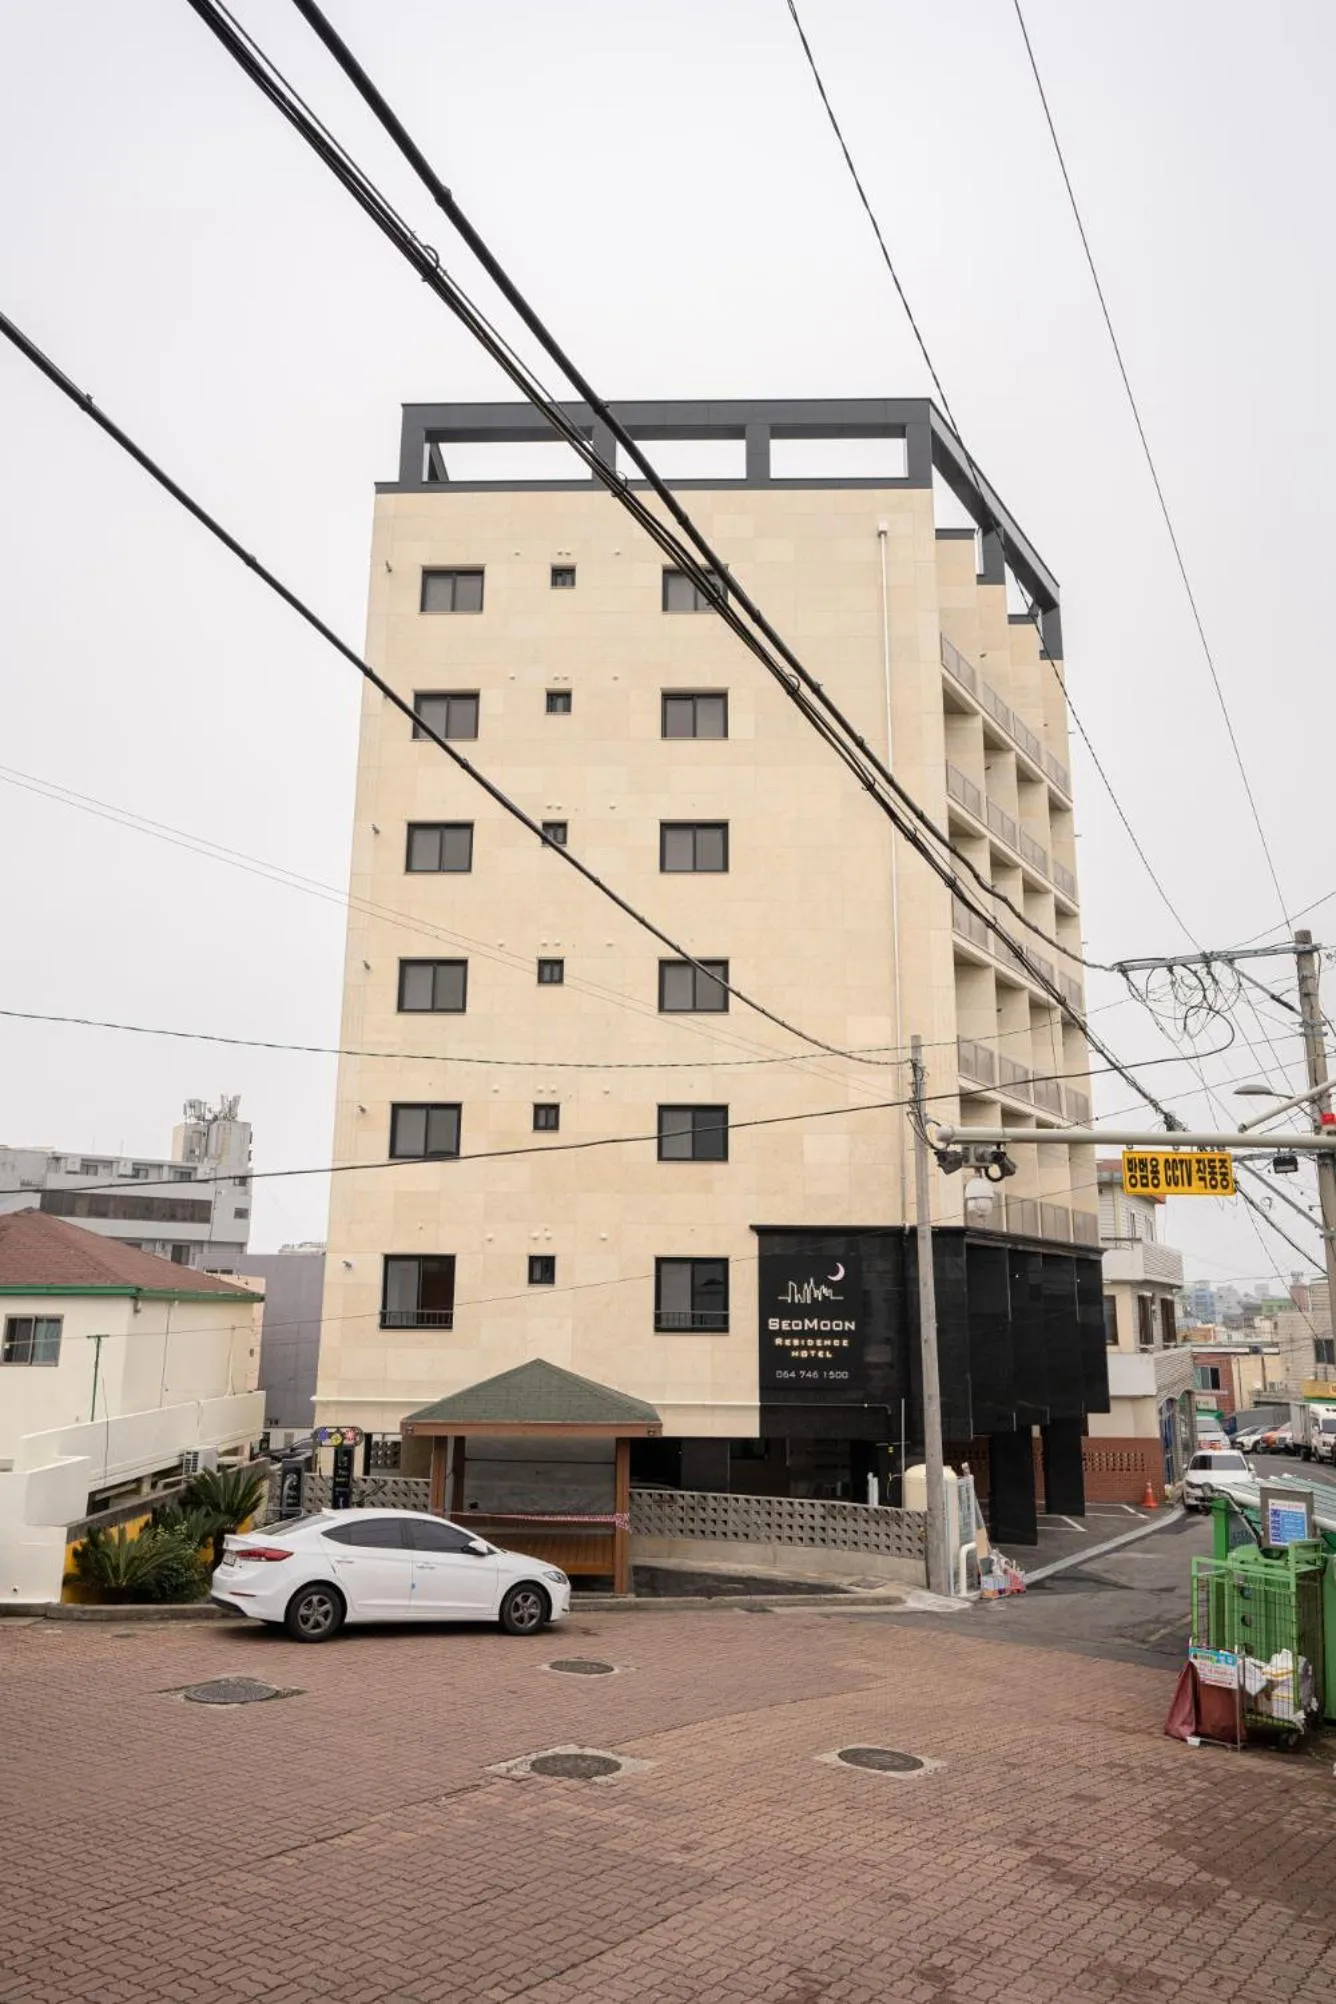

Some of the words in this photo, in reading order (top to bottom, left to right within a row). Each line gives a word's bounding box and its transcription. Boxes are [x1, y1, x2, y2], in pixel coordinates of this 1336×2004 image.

[1126, 1157, 1160, 1188] 방범용
[1164, 1158, 1192, 1187] CCTV
[1196, 1158, 1230, 1189] 작동중
[791, 1350, 833, 1358] HOTEL
